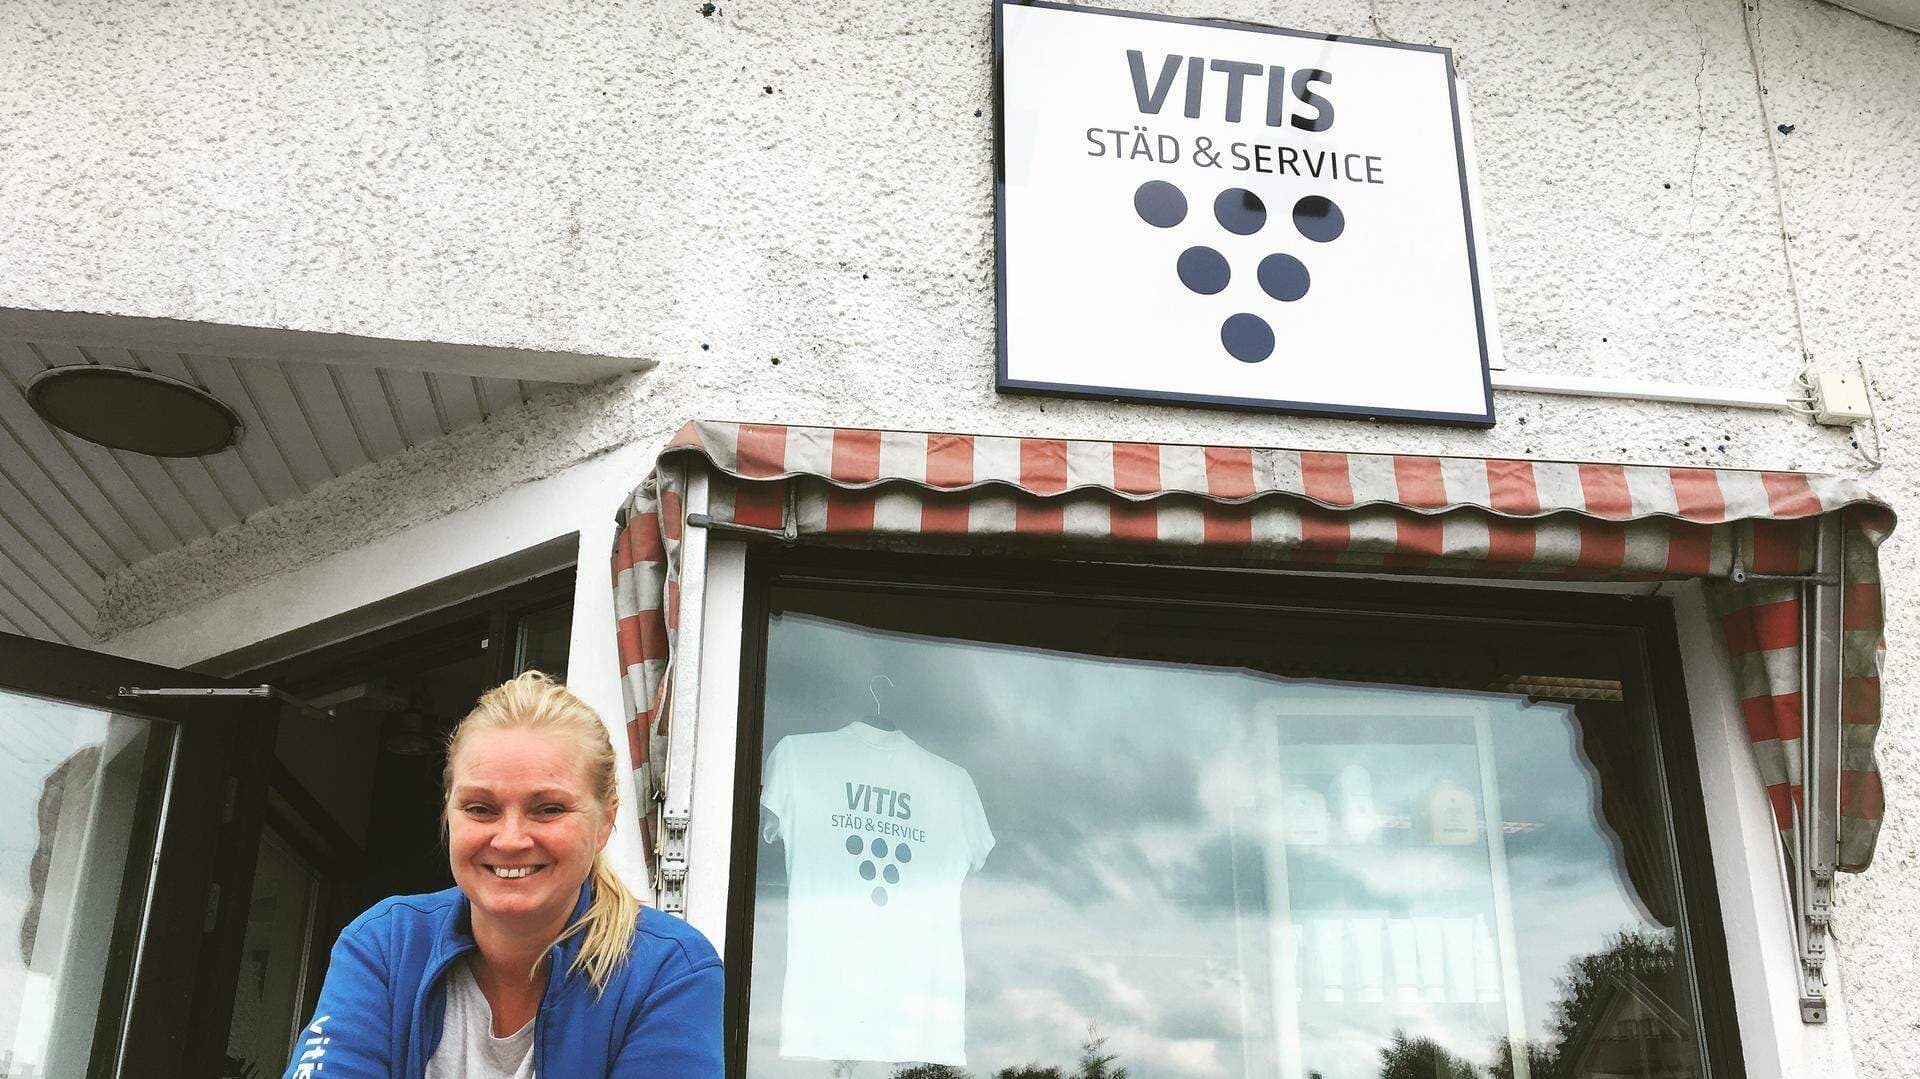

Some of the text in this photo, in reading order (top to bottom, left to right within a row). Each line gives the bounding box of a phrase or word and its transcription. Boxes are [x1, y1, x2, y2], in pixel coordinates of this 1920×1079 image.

[1126, 50, 1335, 133] VITIS
[1086, 126, 1384, 184] STÄD & SERVICE
[845, 782, 911, 820] VITIS
[831, 814, 926, 843] STÄD & SERVICE
